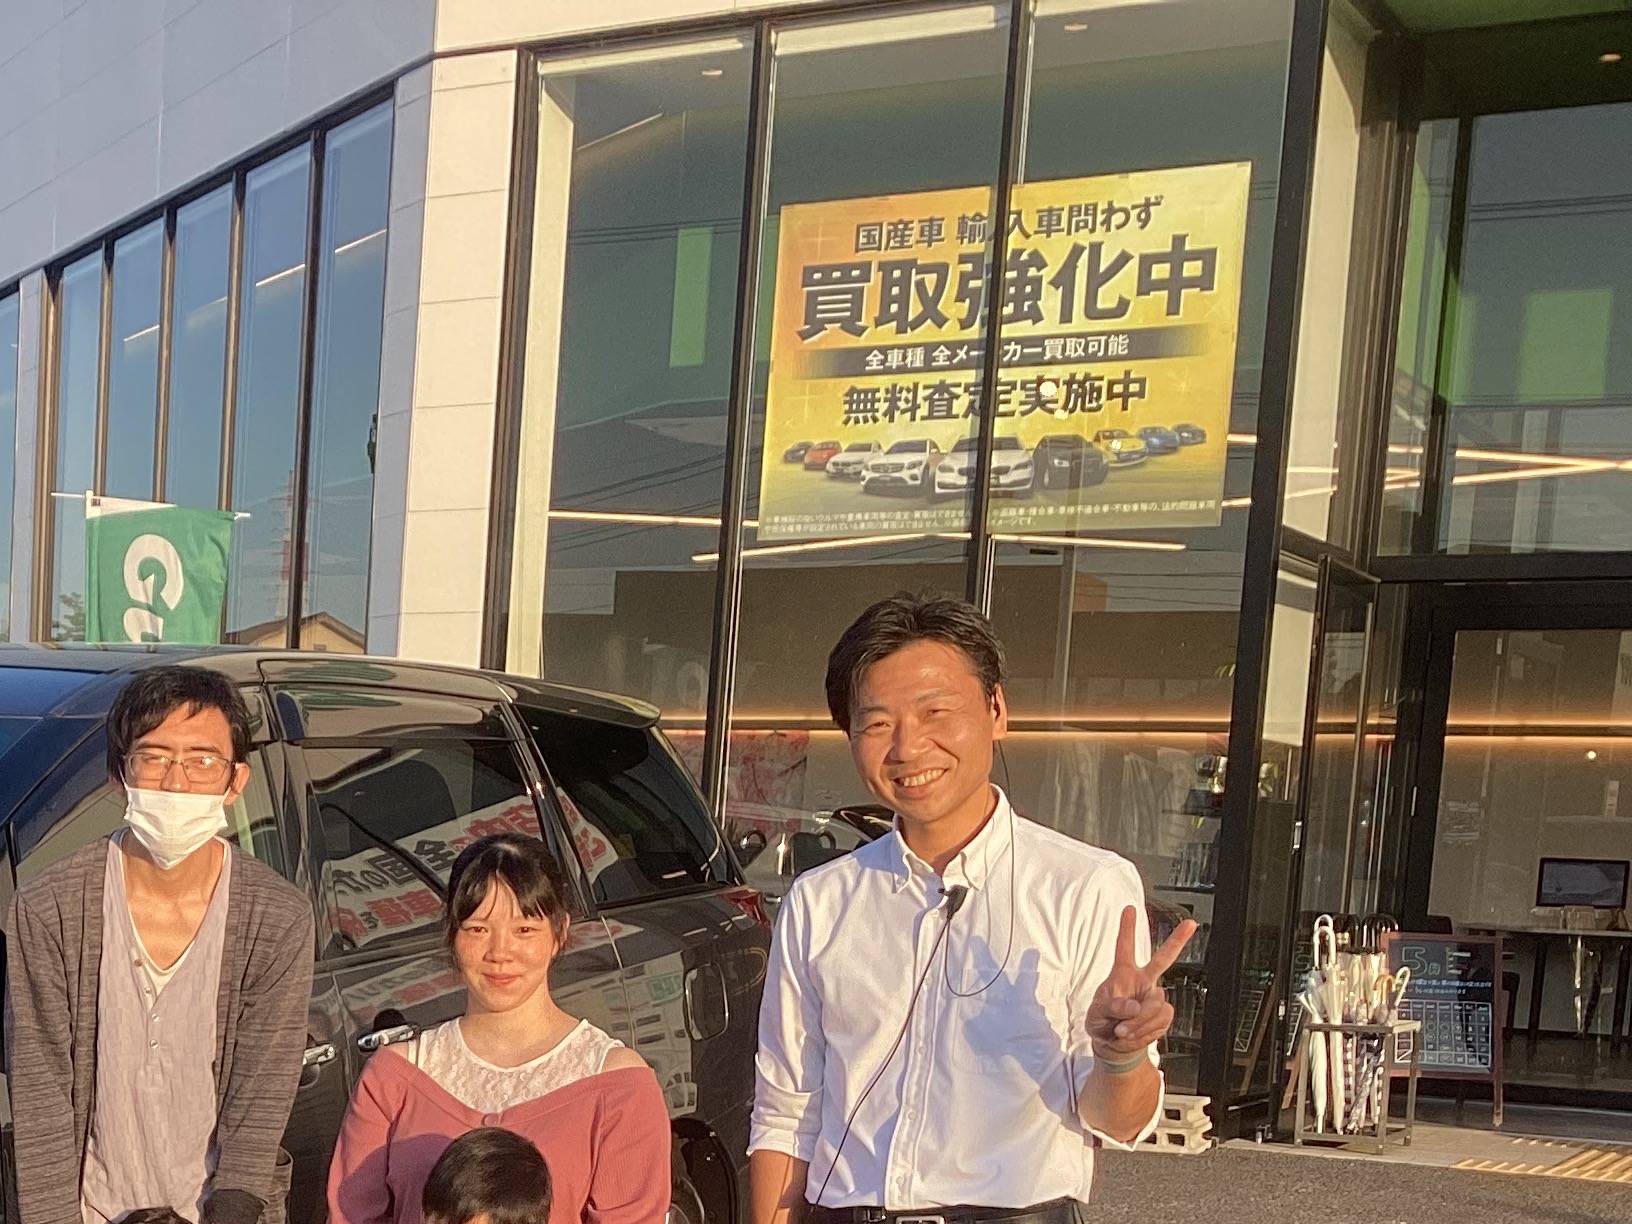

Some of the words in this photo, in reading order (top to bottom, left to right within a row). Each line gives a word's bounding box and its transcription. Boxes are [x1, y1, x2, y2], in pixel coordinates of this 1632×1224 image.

[854, 215, 945, 253] 国産車
[797, 232, 1218, 341] 買取強化中
[864, 345, 926, 371] 全車種
[841, 369, 1148, 426] 無料査定実施中
